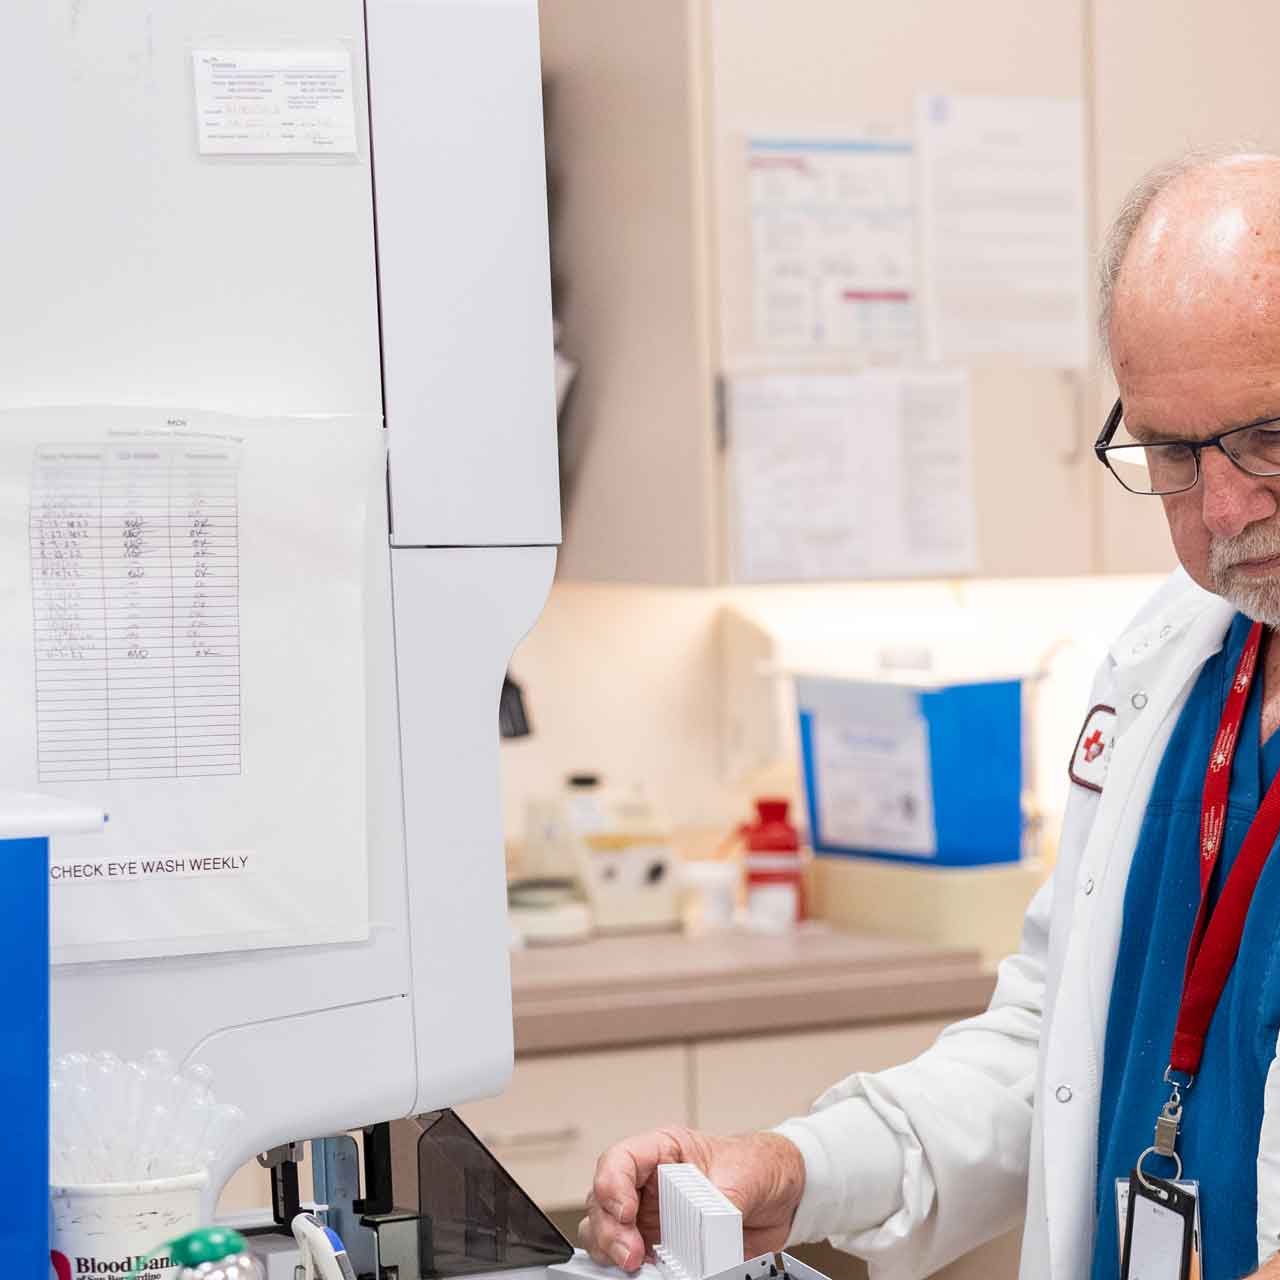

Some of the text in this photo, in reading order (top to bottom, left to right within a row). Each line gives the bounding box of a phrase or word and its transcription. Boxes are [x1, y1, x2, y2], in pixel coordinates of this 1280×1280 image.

[50, 856, 248, 879] CHECK EYE WASH WEEKLY
[75, 1256, 132, 1274] Blood
